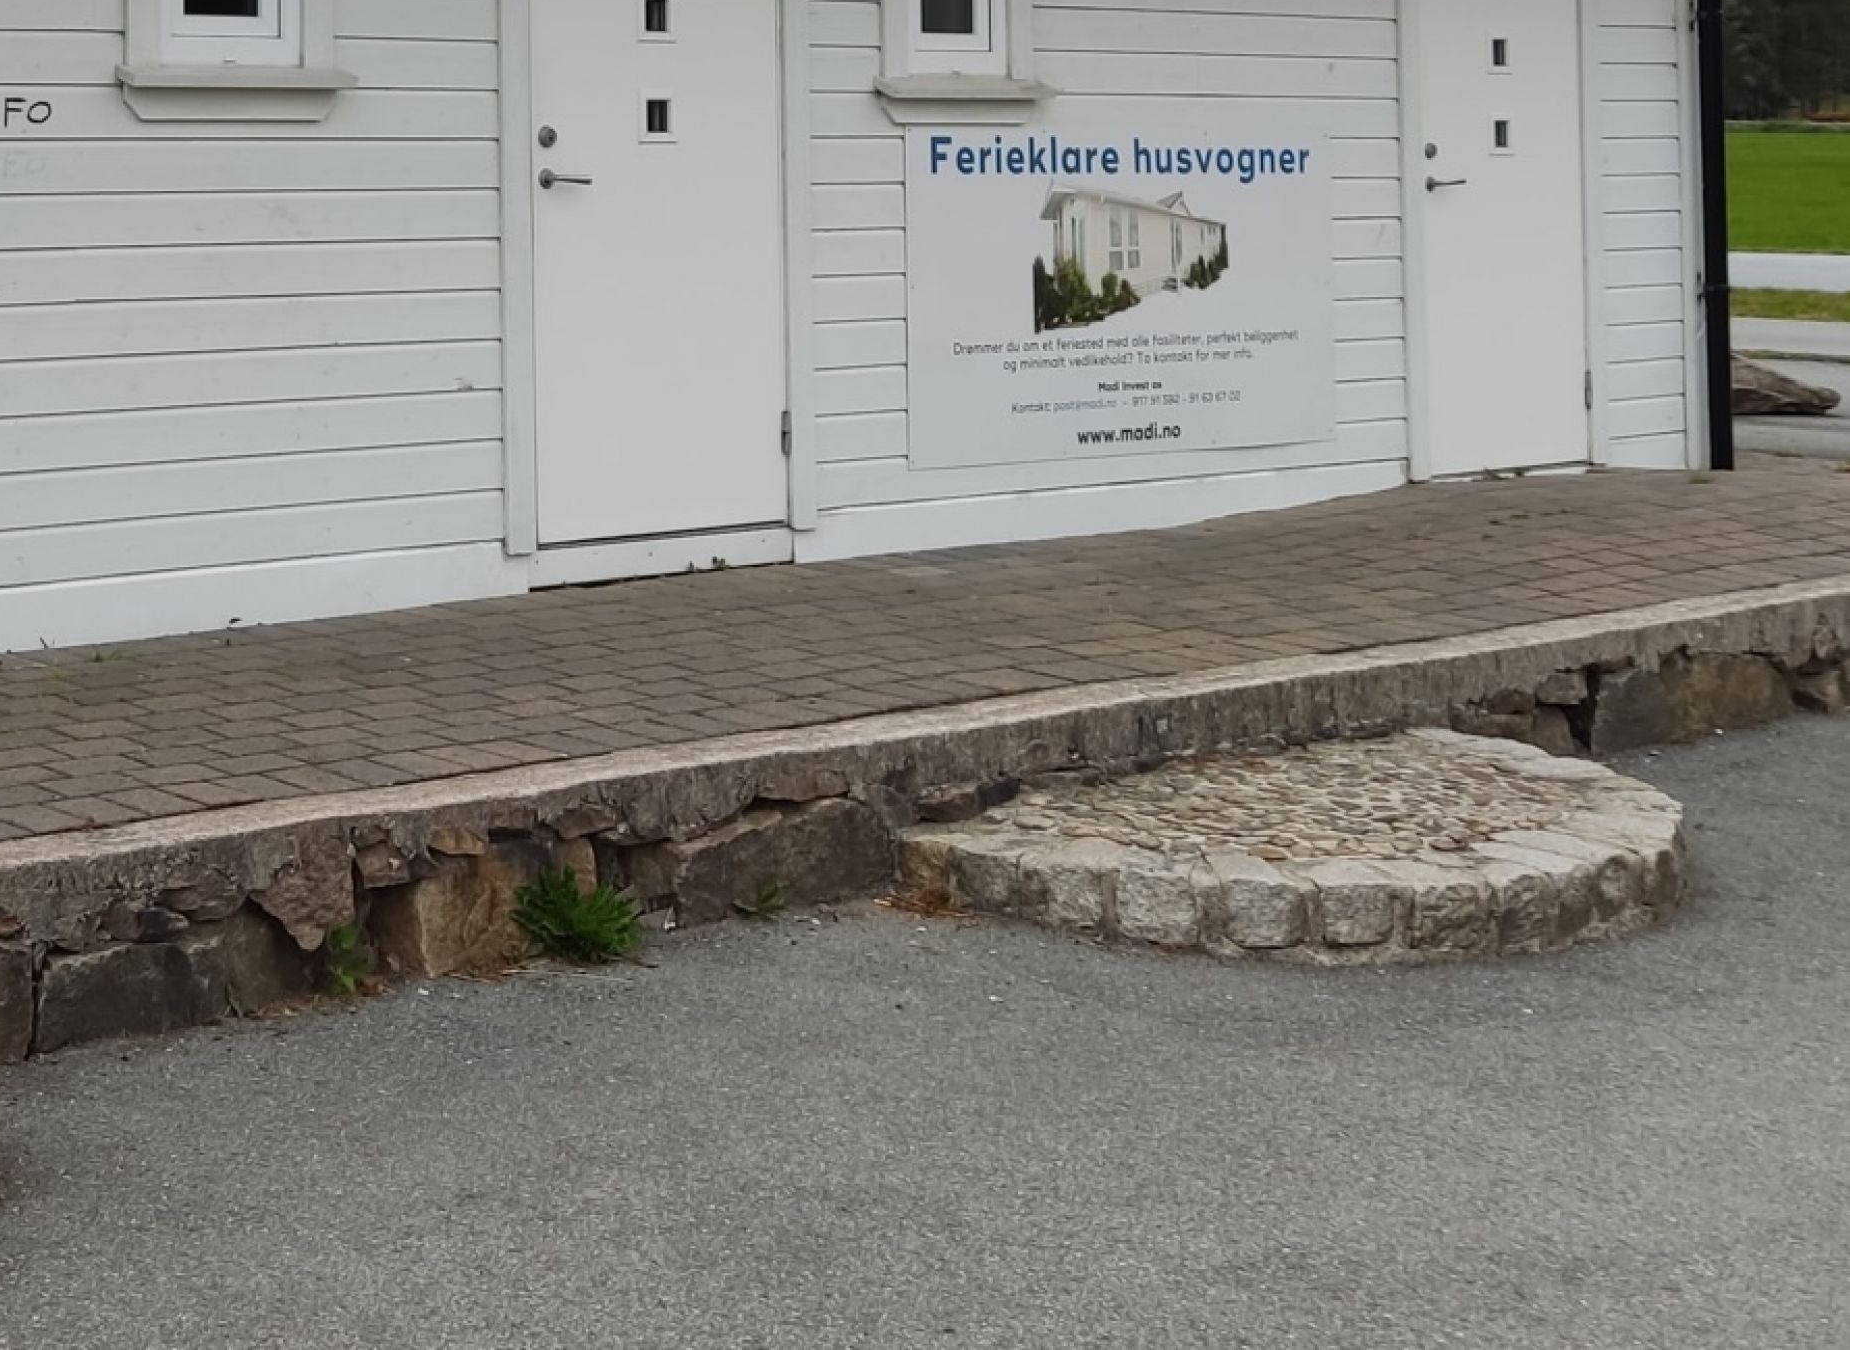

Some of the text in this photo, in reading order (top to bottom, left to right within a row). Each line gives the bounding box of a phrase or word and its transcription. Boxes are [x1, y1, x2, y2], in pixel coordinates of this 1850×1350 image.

[929, 135, 1311, 183] Ferieklare husvogner
[953, 342, 1003, 355] Drømmer
[1006, 341, 1020, 352] du
[1023, 341, 1039, 352] om
[1042, 340, 1054, 351] et
[1057, 336, 1104, 350] feriested
[1107, 336, 1129, 348] med
[1207, 331, 1242, 346] perfekt
[1003, 361, 1017, 374] og
[1020, 356, 1067, 370] minimalt
[1069, 352, 1134, 367] vedlikehold?
[1137, 351, 1151, 364] Ta
[1154, 350, 1194, 364] kontakt
[1196, 349, 1210, 361] for
[1212, 349, 1231, 360] mer
[1077, 421, 1181, 445] www.madi.no
